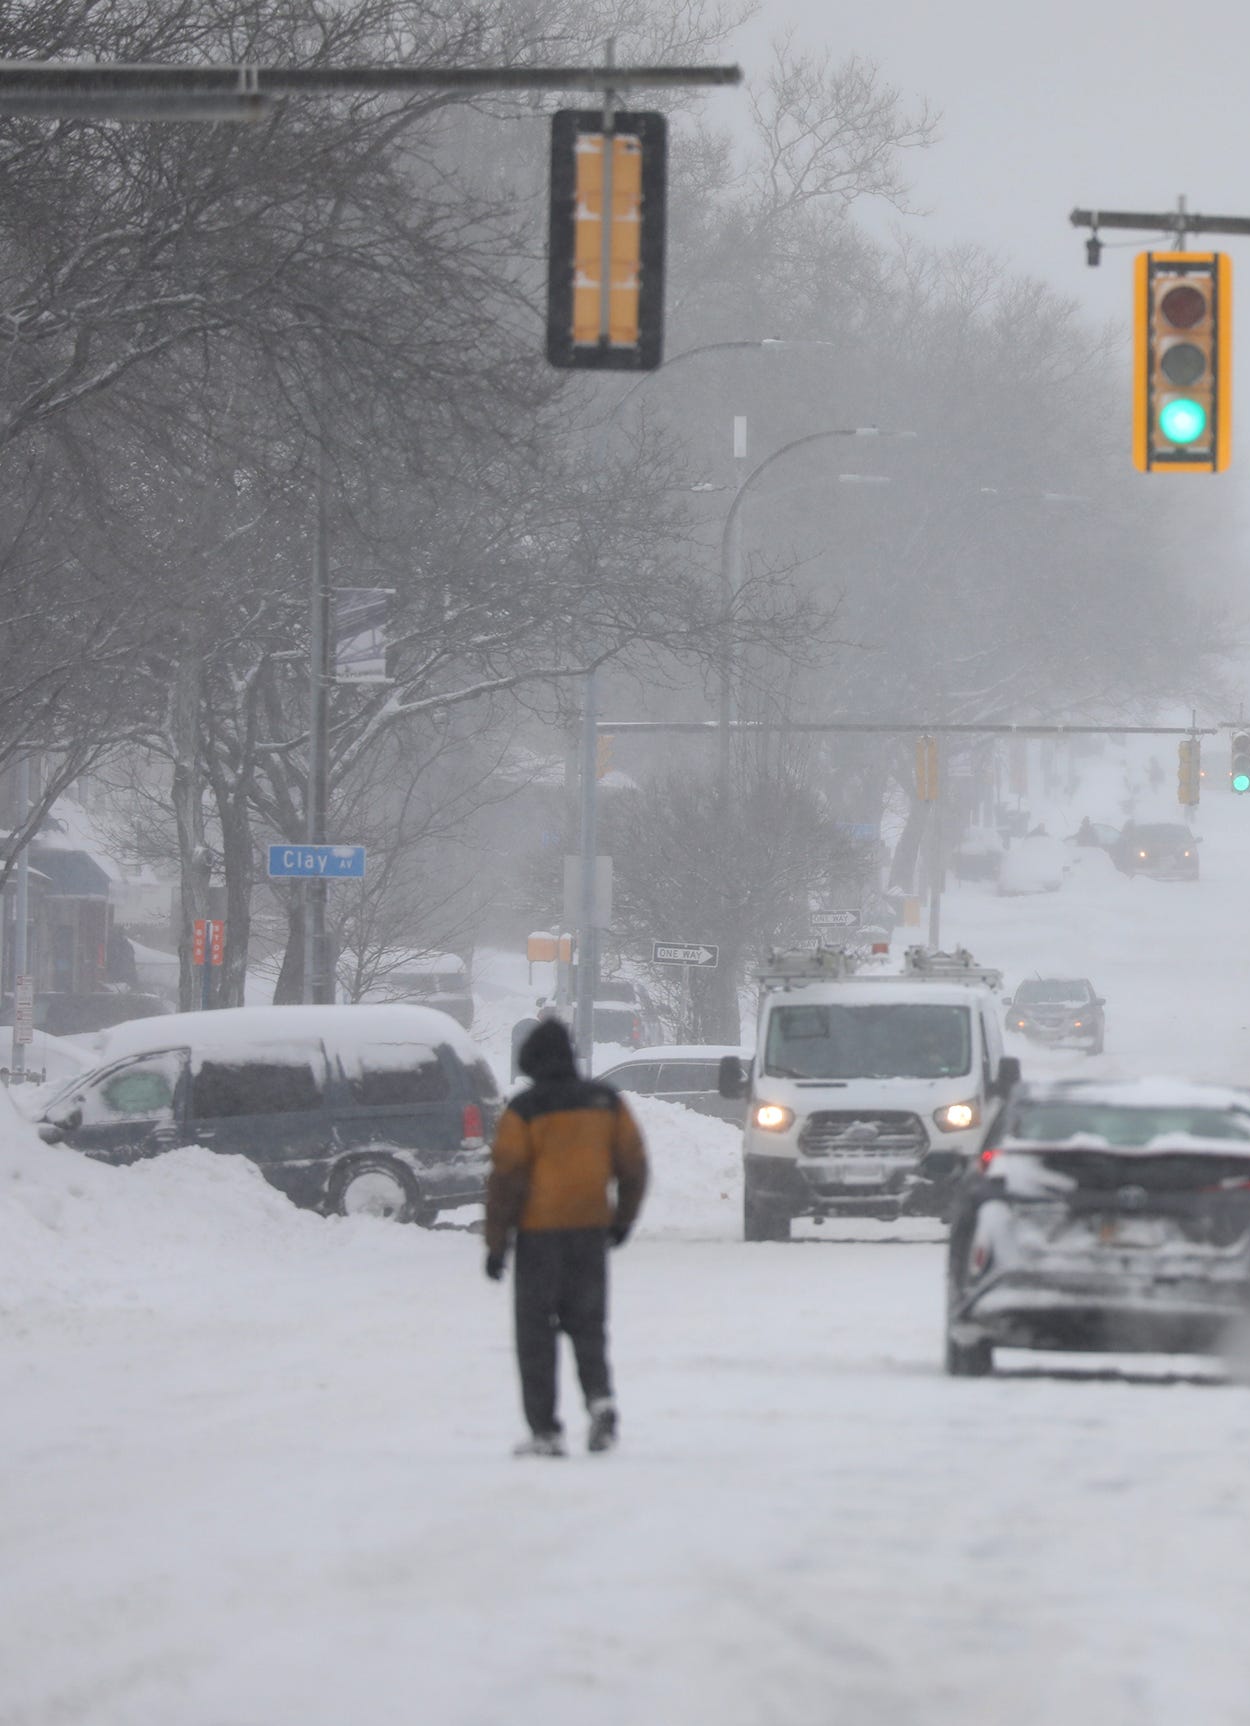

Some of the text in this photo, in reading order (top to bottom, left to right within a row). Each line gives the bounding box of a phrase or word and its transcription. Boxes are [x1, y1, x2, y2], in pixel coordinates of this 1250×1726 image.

[283, 850, 353, 873] Clay AV
[832, 914, 849, 923] WAY
[195, 928, 203, 956] BUS
[212, 925, 220, 960] STOP
[658, 948, 702, 961] ONE WAY
